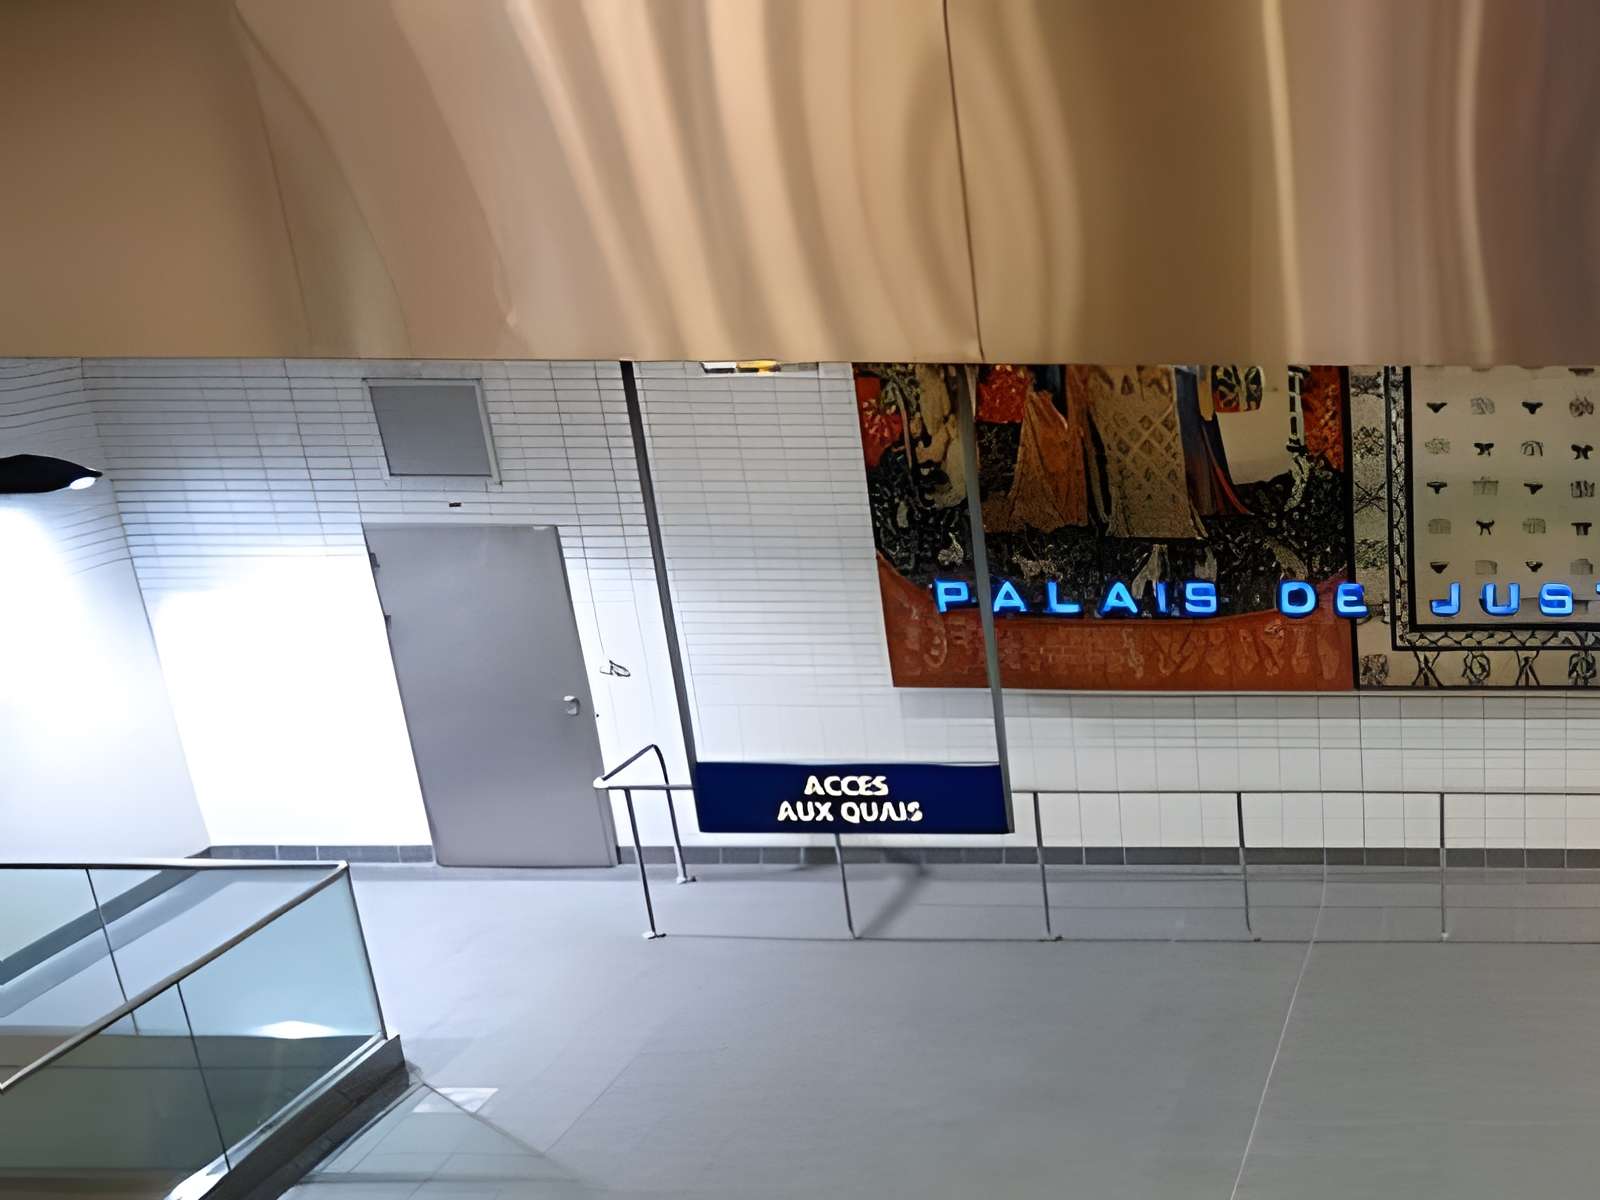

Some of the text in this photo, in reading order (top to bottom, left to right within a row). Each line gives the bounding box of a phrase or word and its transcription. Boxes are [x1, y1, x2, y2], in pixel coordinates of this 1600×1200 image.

[935, 579, 1218, 616] PALAIS
[1277, 580, 1368, 617] DE
[803, 775, 889, 796] ACCES
[777, 800, 923, 823] AUX QUAIS
